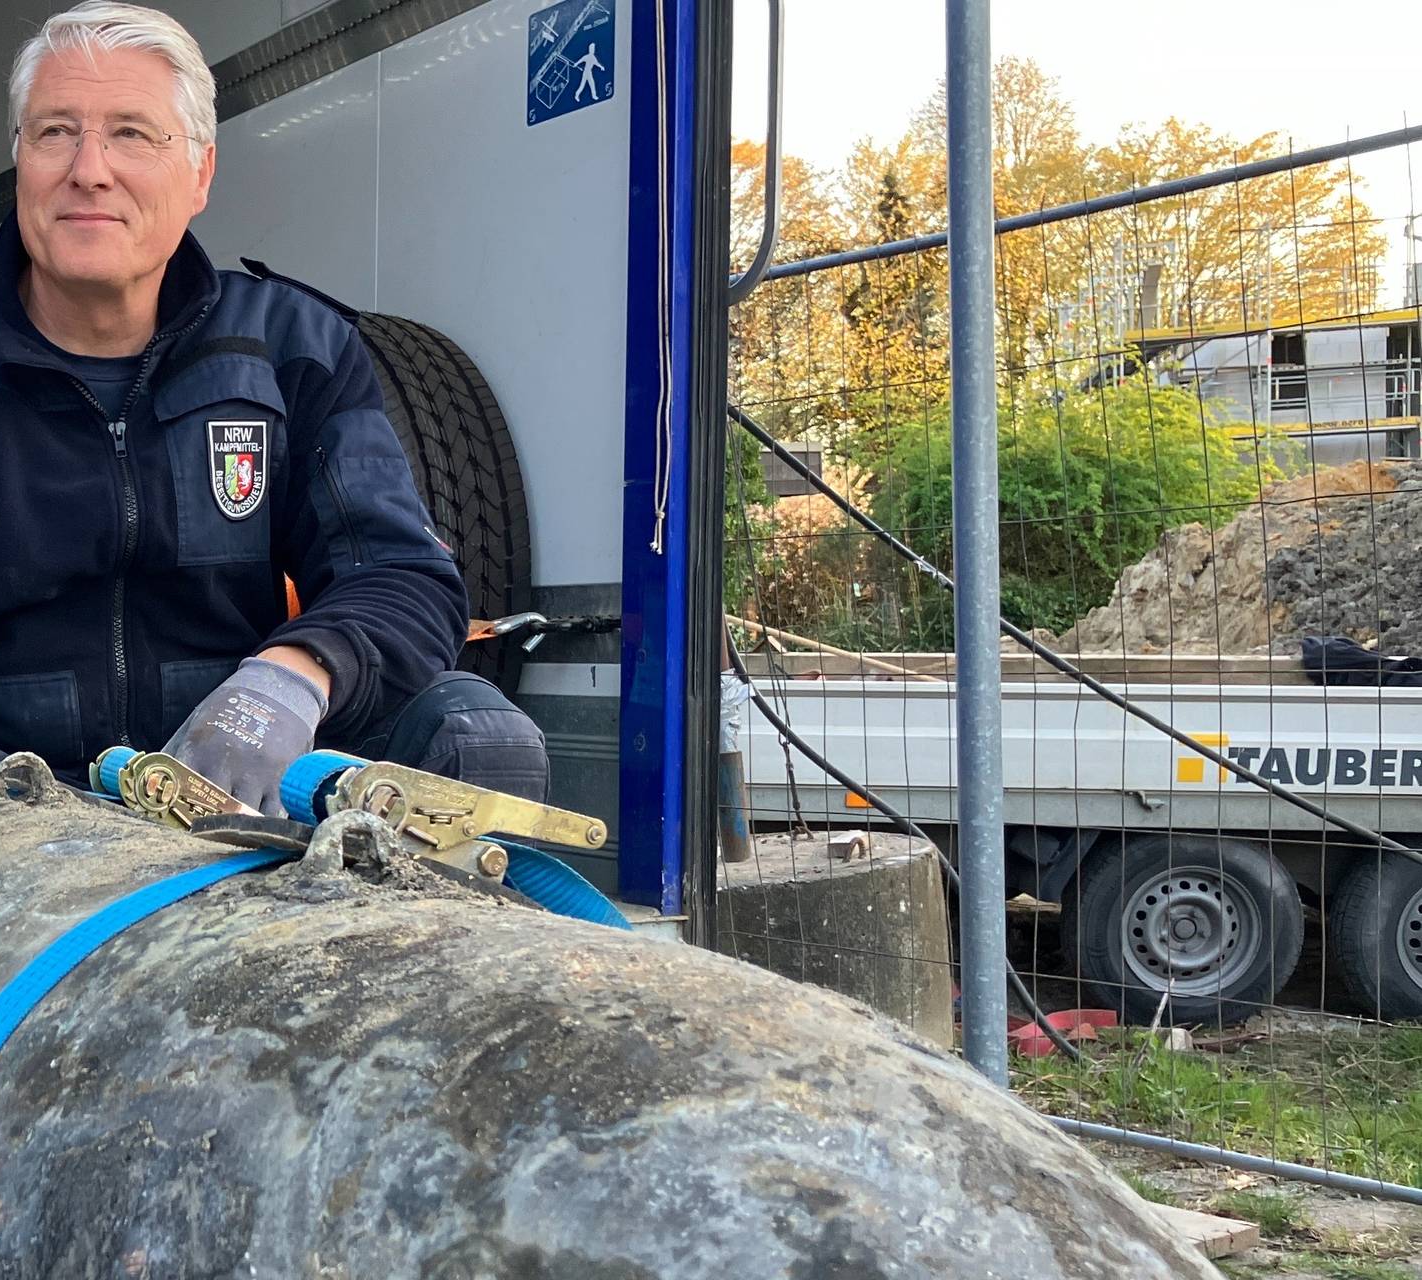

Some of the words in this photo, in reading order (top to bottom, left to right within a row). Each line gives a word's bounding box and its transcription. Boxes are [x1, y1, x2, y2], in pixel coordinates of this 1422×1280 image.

[214, 442, 263, 452] KAMPFMITTEL-
[224, 427, 253, 442] NRW
[215, 470, 262, 513] BESEITIGUNGSDIENST
[1228, 747, 1422, 786] TAUBER
